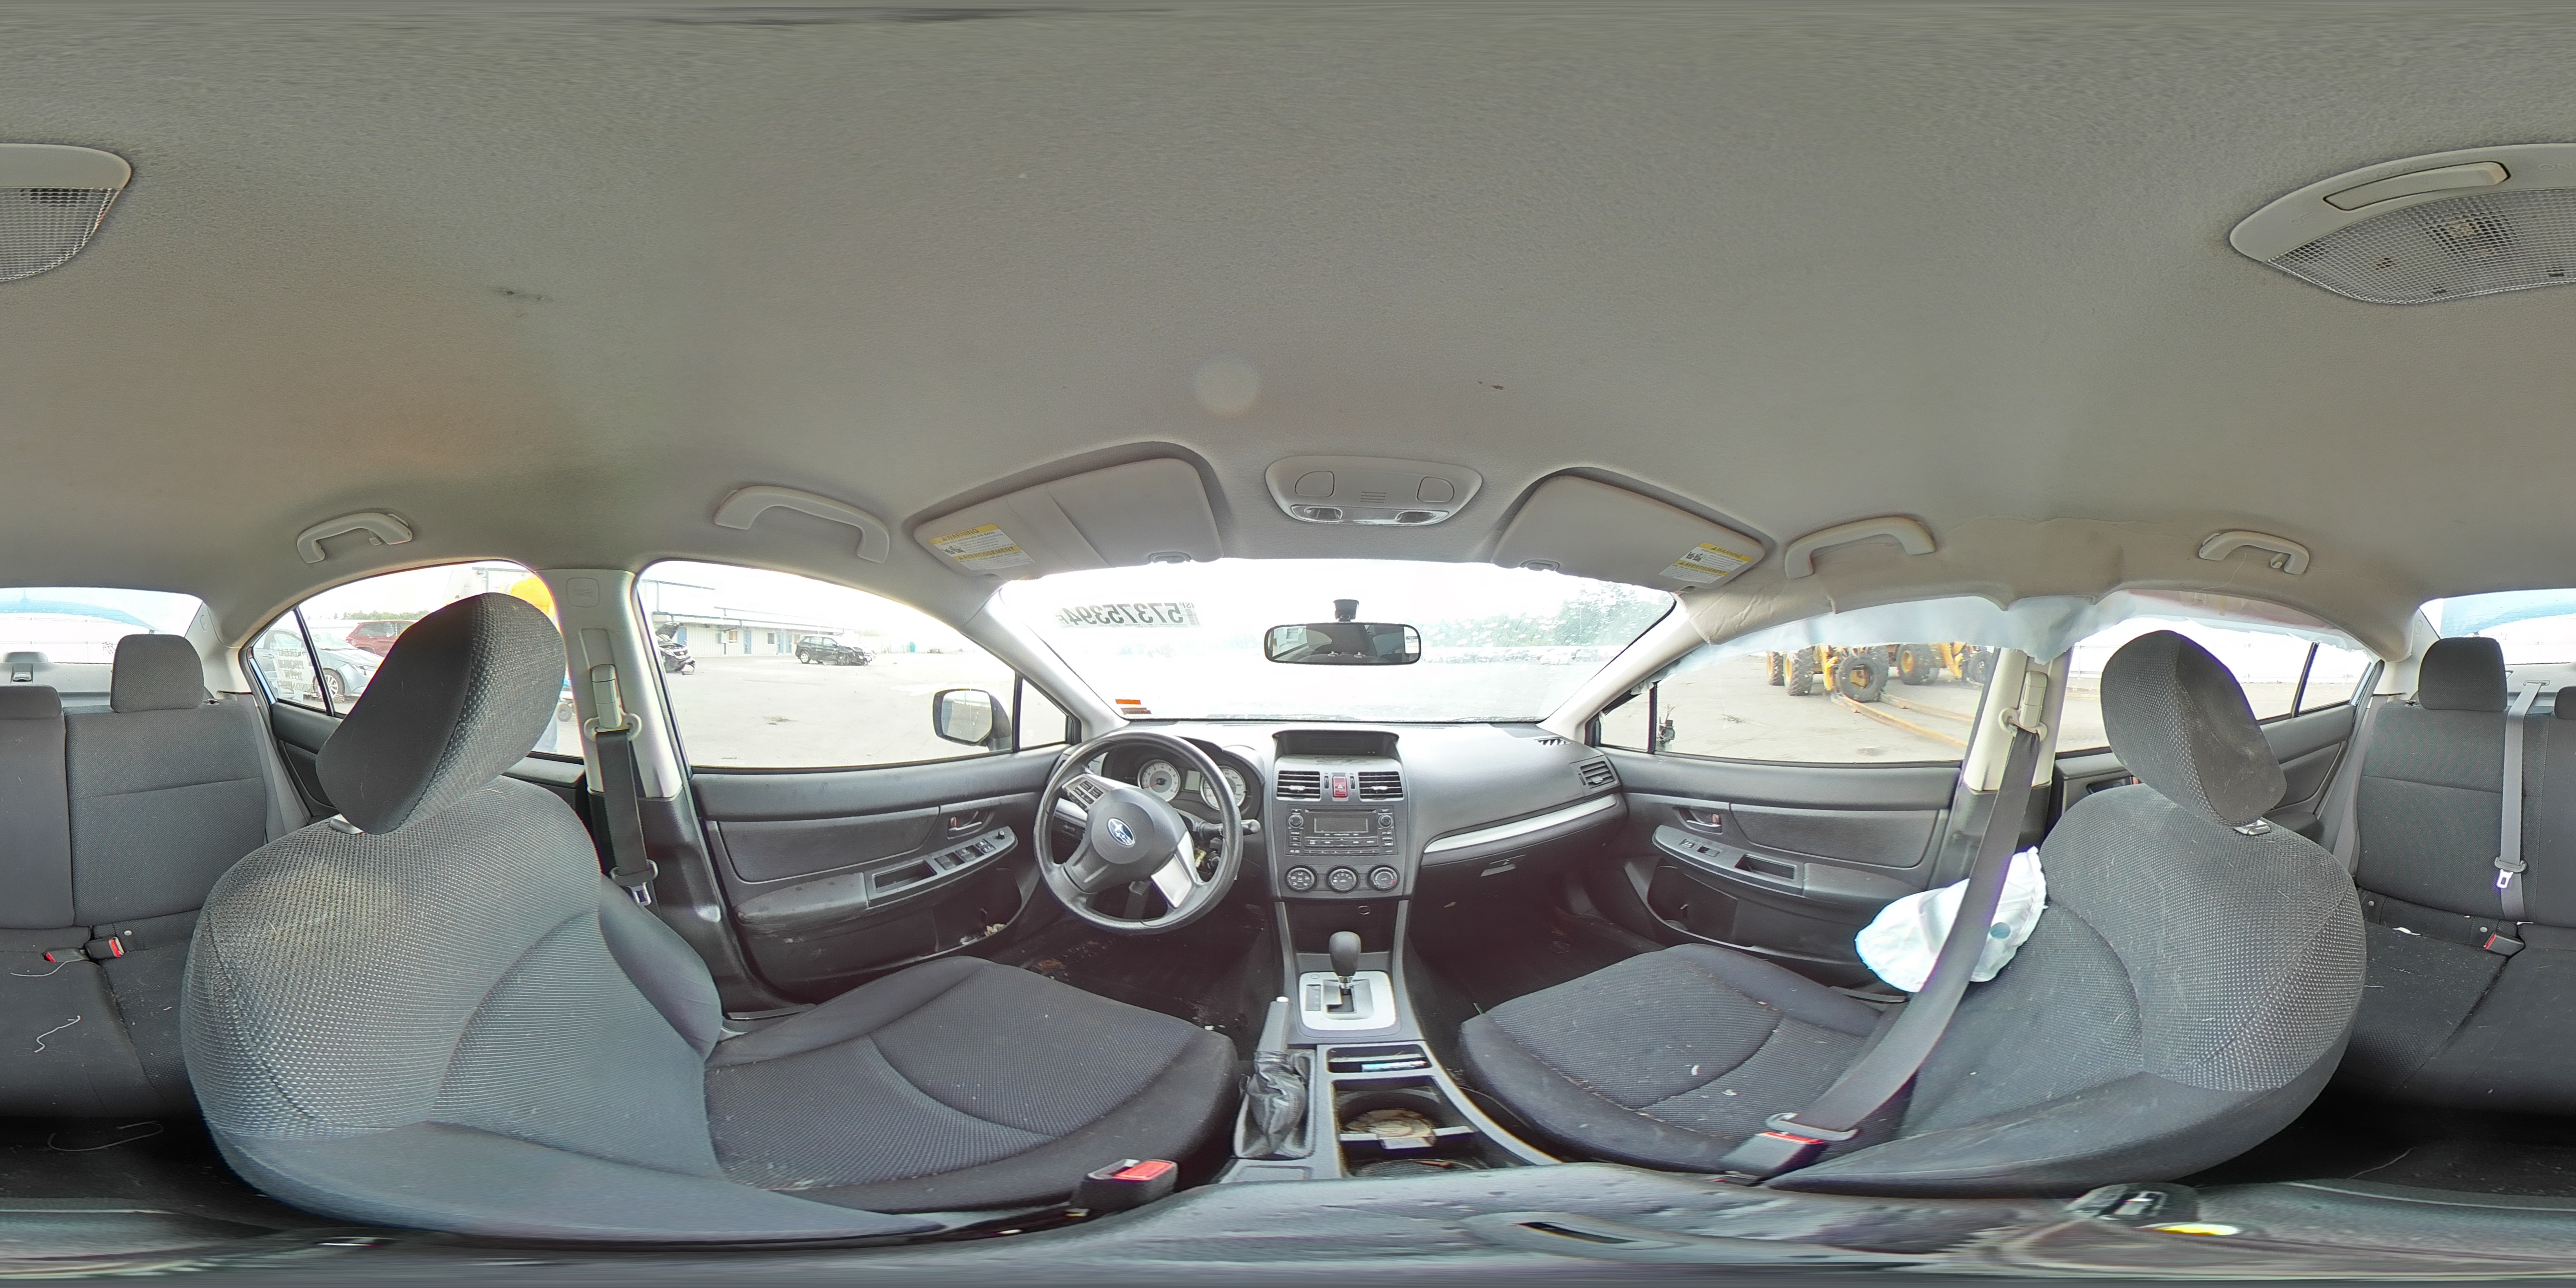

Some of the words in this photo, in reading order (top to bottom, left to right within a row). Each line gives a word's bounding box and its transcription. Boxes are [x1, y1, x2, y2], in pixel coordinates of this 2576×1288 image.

[2538, 163, 2573, 171] ON
[2289, 211, 2313, 225] OFF
[946, 529, 979, 540] WARNING
[963, 547, 1015, 559] AVERTISSEMENT
[1716, 547, 1743, 558] WARNING
